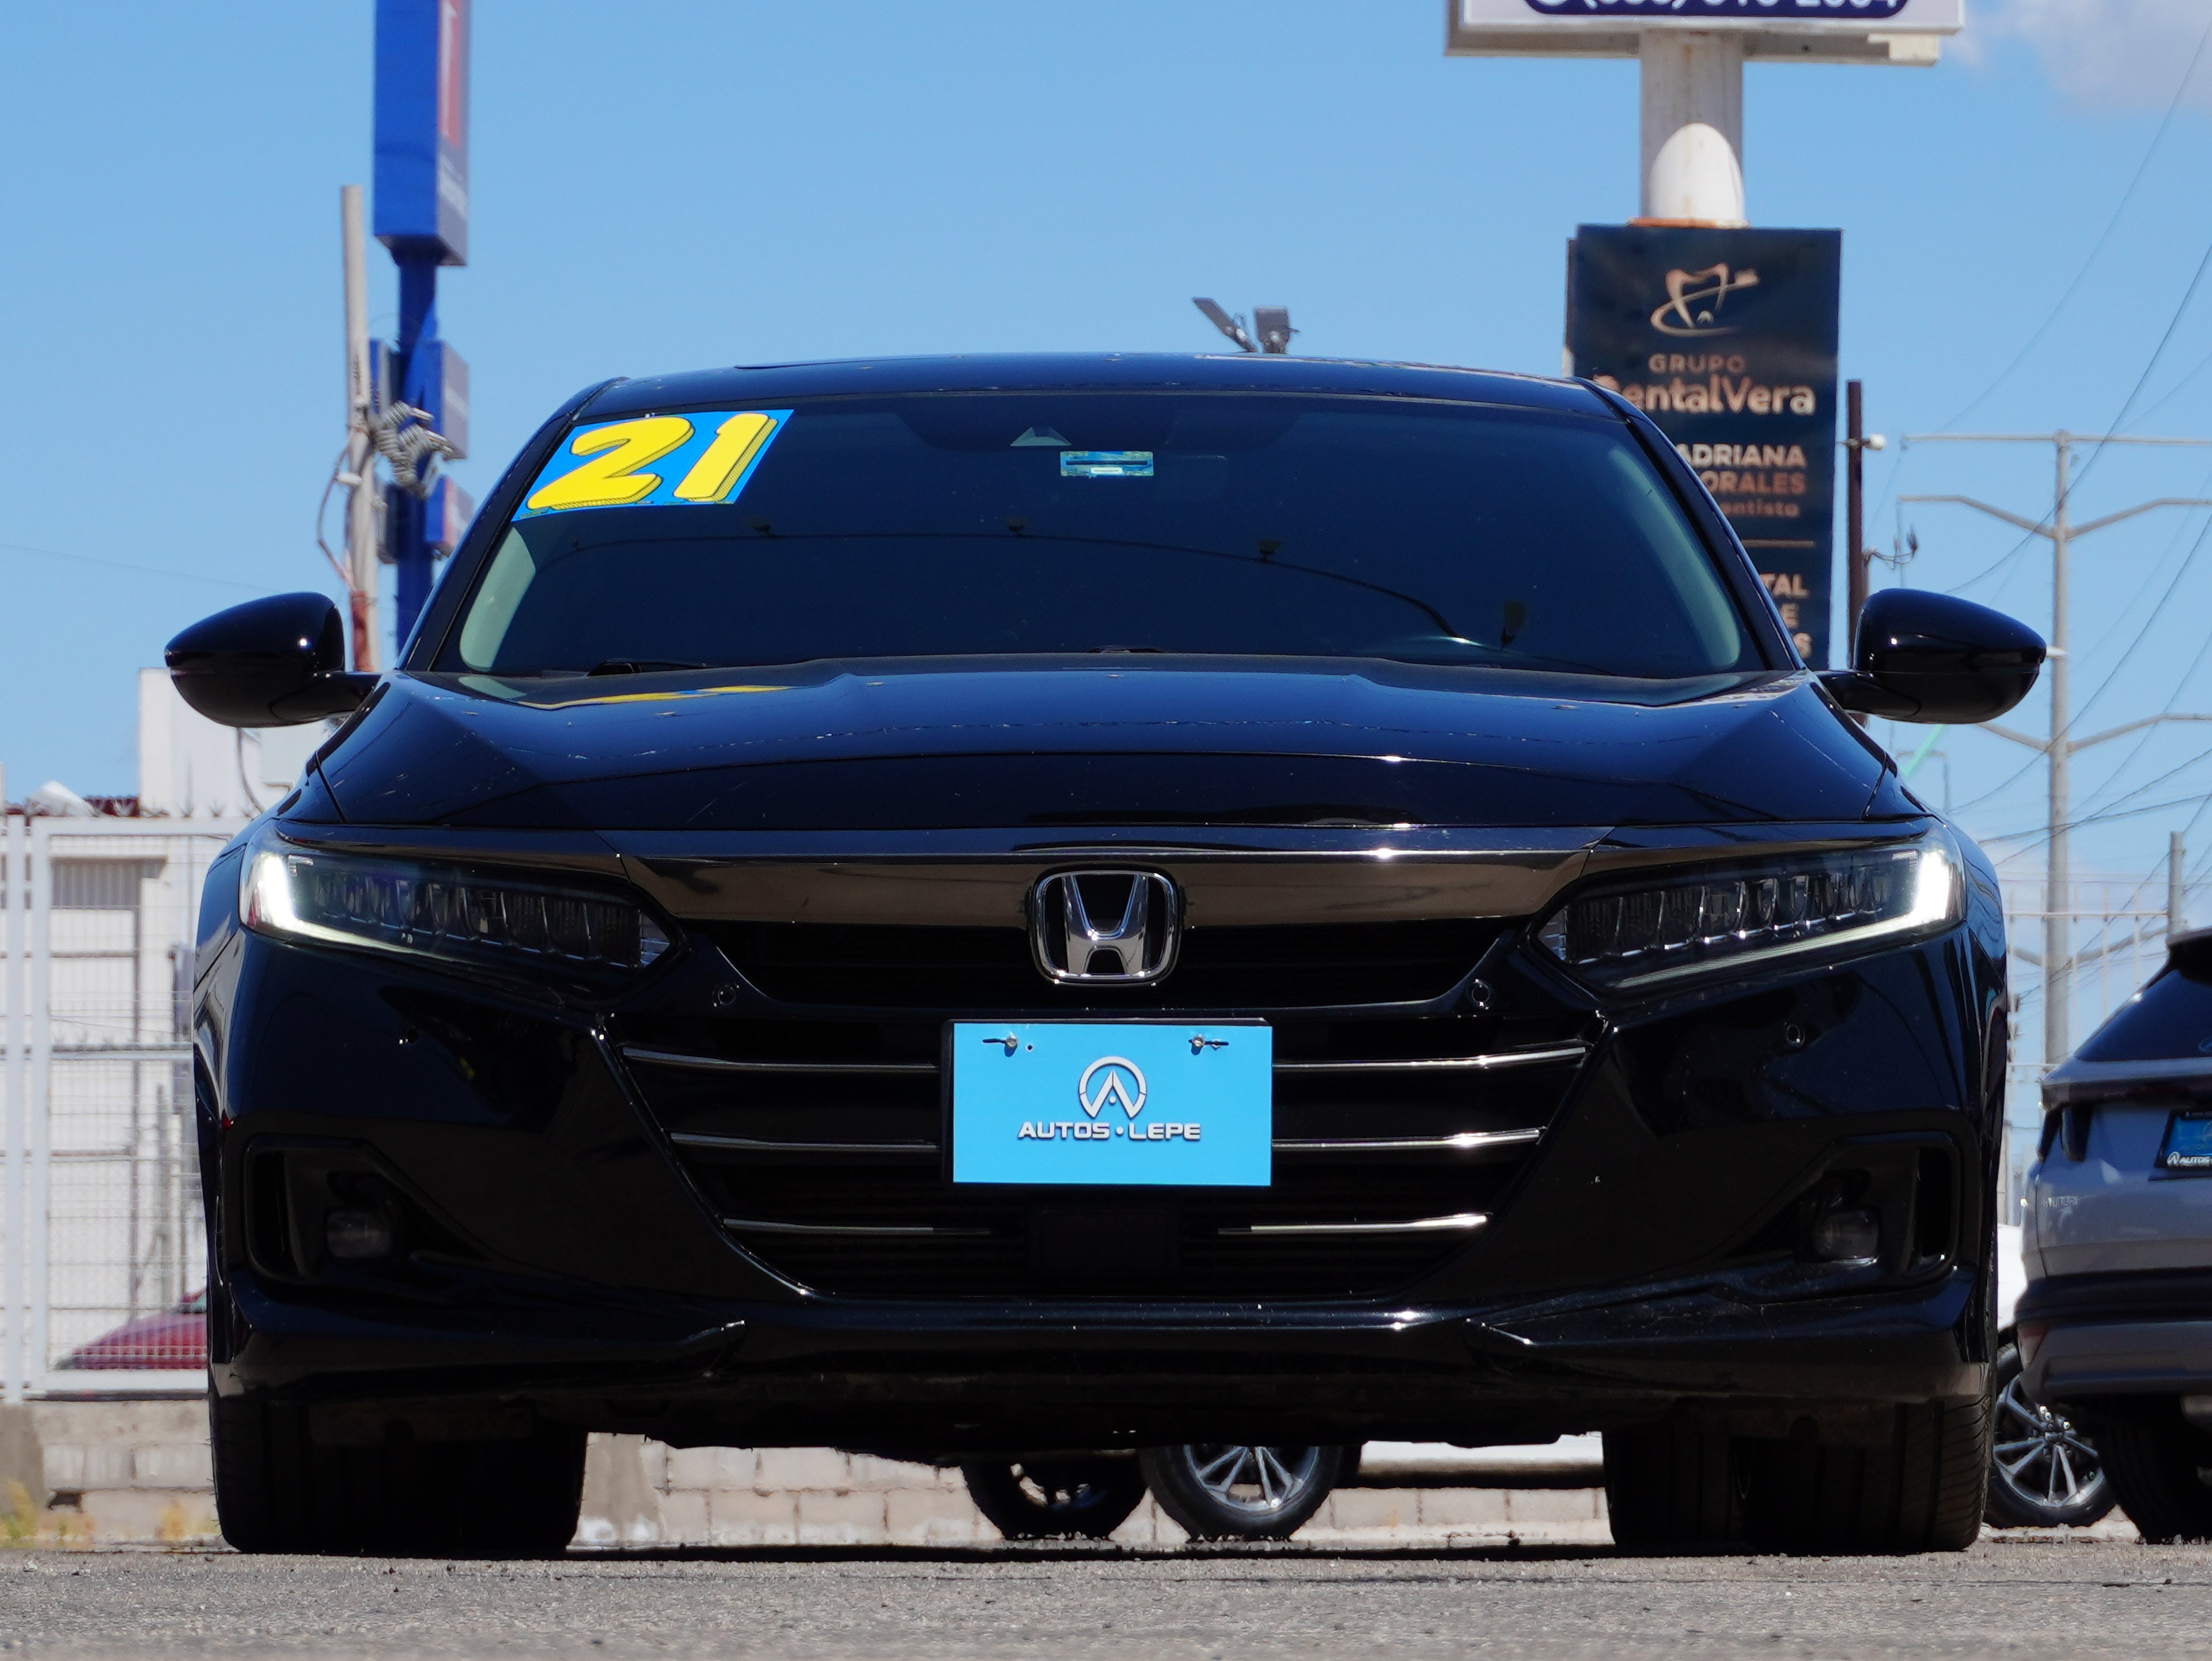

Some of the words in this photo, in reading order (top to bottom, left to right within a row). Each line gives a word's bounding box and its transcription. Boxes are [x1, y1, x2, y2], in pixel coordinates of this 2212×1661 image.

[1647, 353, 1746, 374] GRUPO
[527, 412, 778, 510] 21
[1699, 471, 1806, 495] ORALES
[1759, 573, 1810, 599] TAL
[1017, 1121, 1110, 1140] AUTOS
[1128, 1122, 1201, 1140] LEPE
